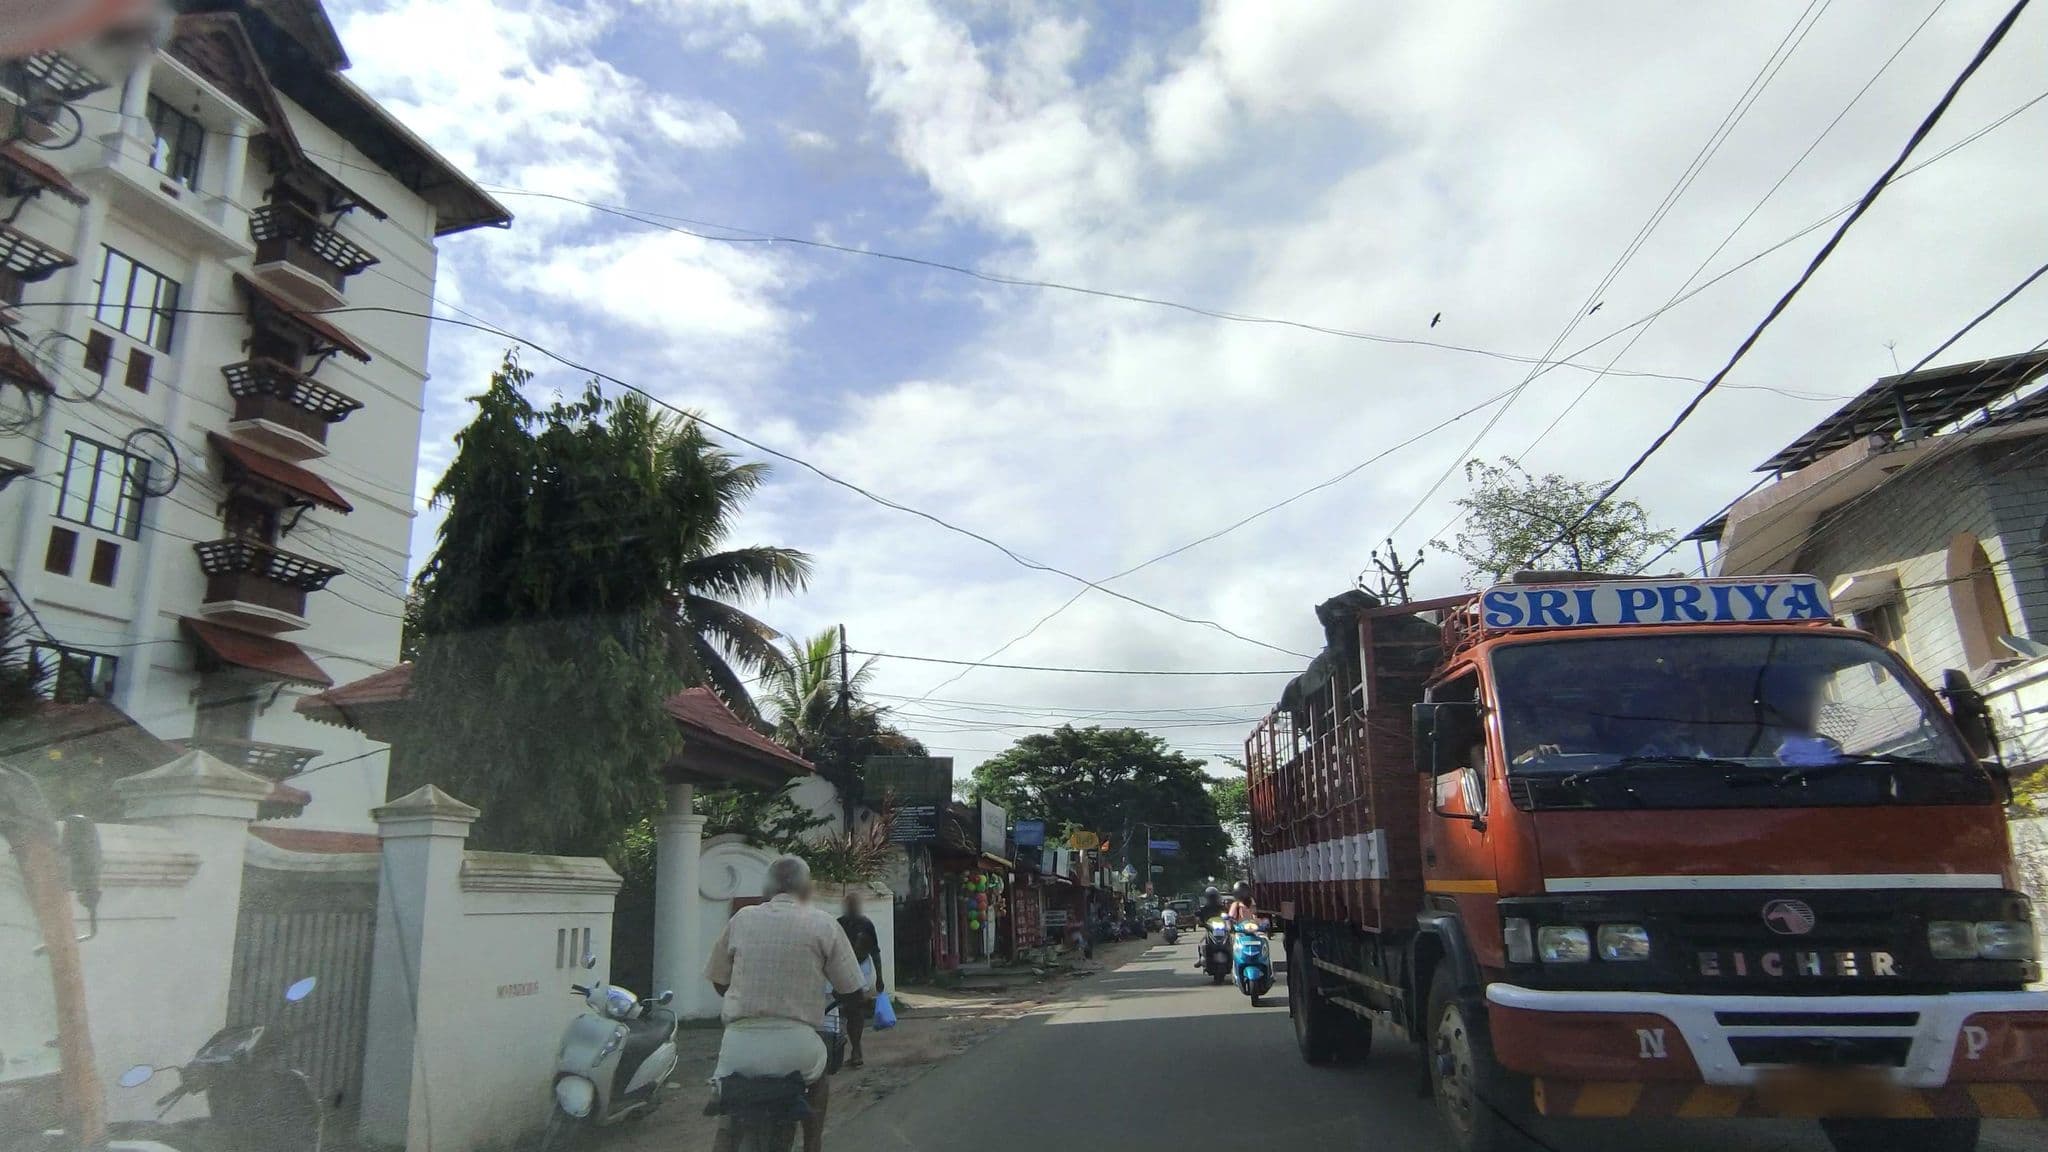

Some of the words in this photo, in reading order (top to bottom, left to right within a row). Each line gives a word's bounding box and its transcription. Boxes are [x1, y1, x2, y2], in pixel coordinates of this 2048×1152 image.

[1485, 589, 1597, 627] SRI
[1615, 582, 1832, 624] PRIYA
[1699, 951, 1898, 977] EICHER
[1636, 1028, 1667, 1058] N
[1963, 1025, 1989, 1059] P
